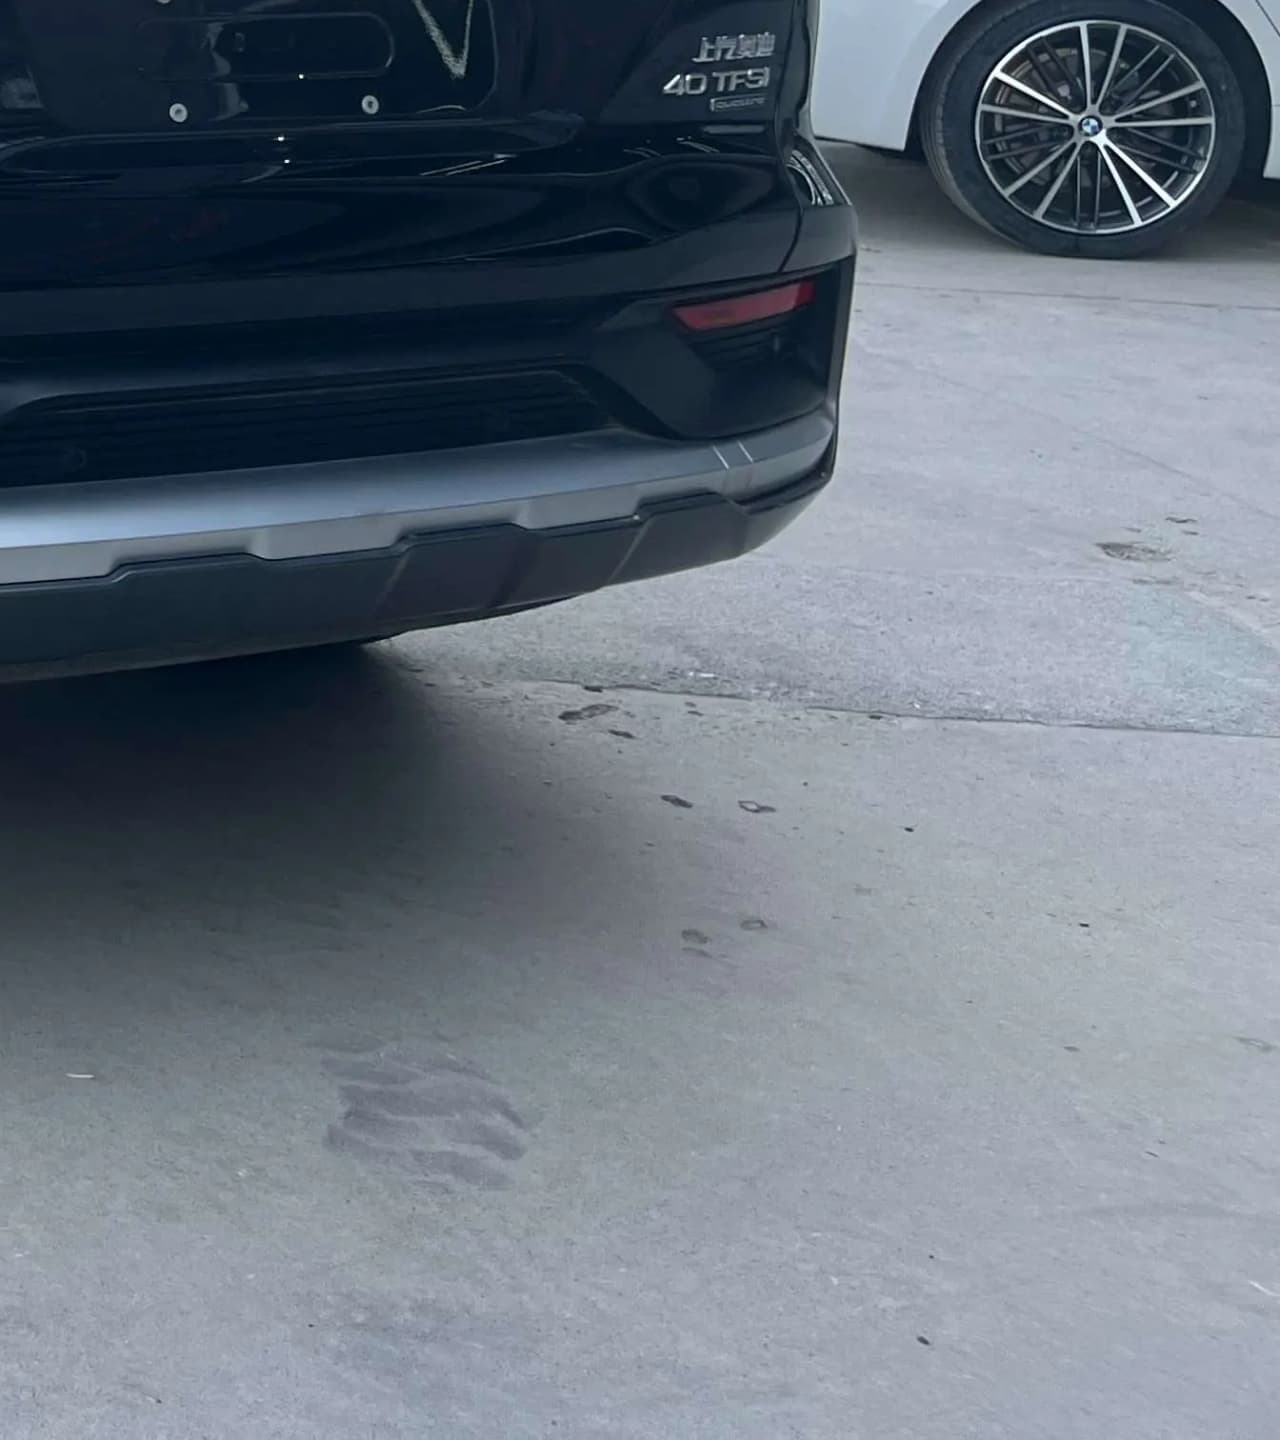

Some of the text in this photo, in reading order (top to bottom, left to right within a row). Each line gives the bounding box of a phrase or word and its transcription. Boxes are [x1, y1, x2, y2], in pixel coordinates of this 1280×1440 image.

[691, 31, 776, 63] 上汽奥迪
[663, 66, 771, 96] 40 TFSI
